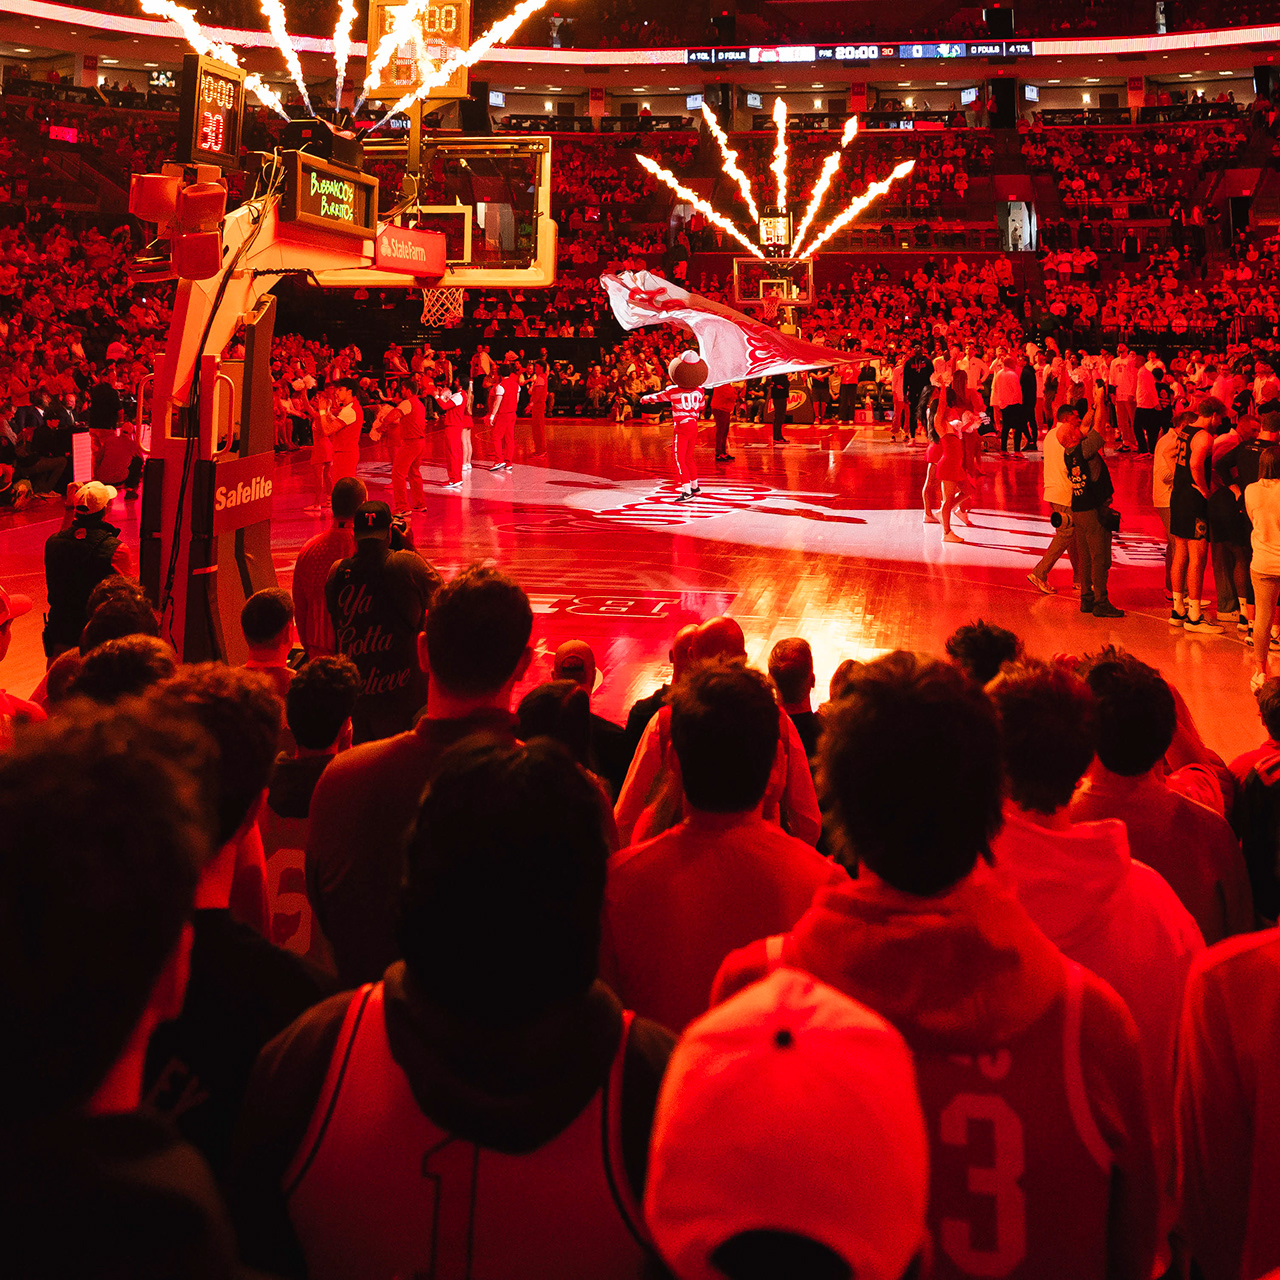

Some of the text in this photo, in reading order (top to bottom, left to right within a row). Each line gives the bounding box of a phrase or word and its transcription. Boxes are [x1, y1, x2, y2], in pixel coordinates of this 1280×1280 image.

[834, 45, 878, 60] 20:00
[881, 48, 894, 56] 30
[977, 45, 1000, 54] FOULS
[320, 195, 354, 221] BURRITOS
[215, 475, 273, 512] Safelite
[364, 512, 377, 527] T
[337, 583, 373, 629] Ya
[336, 625, 393, 661] Gotta
[357, 666, 412, 699] elieve
